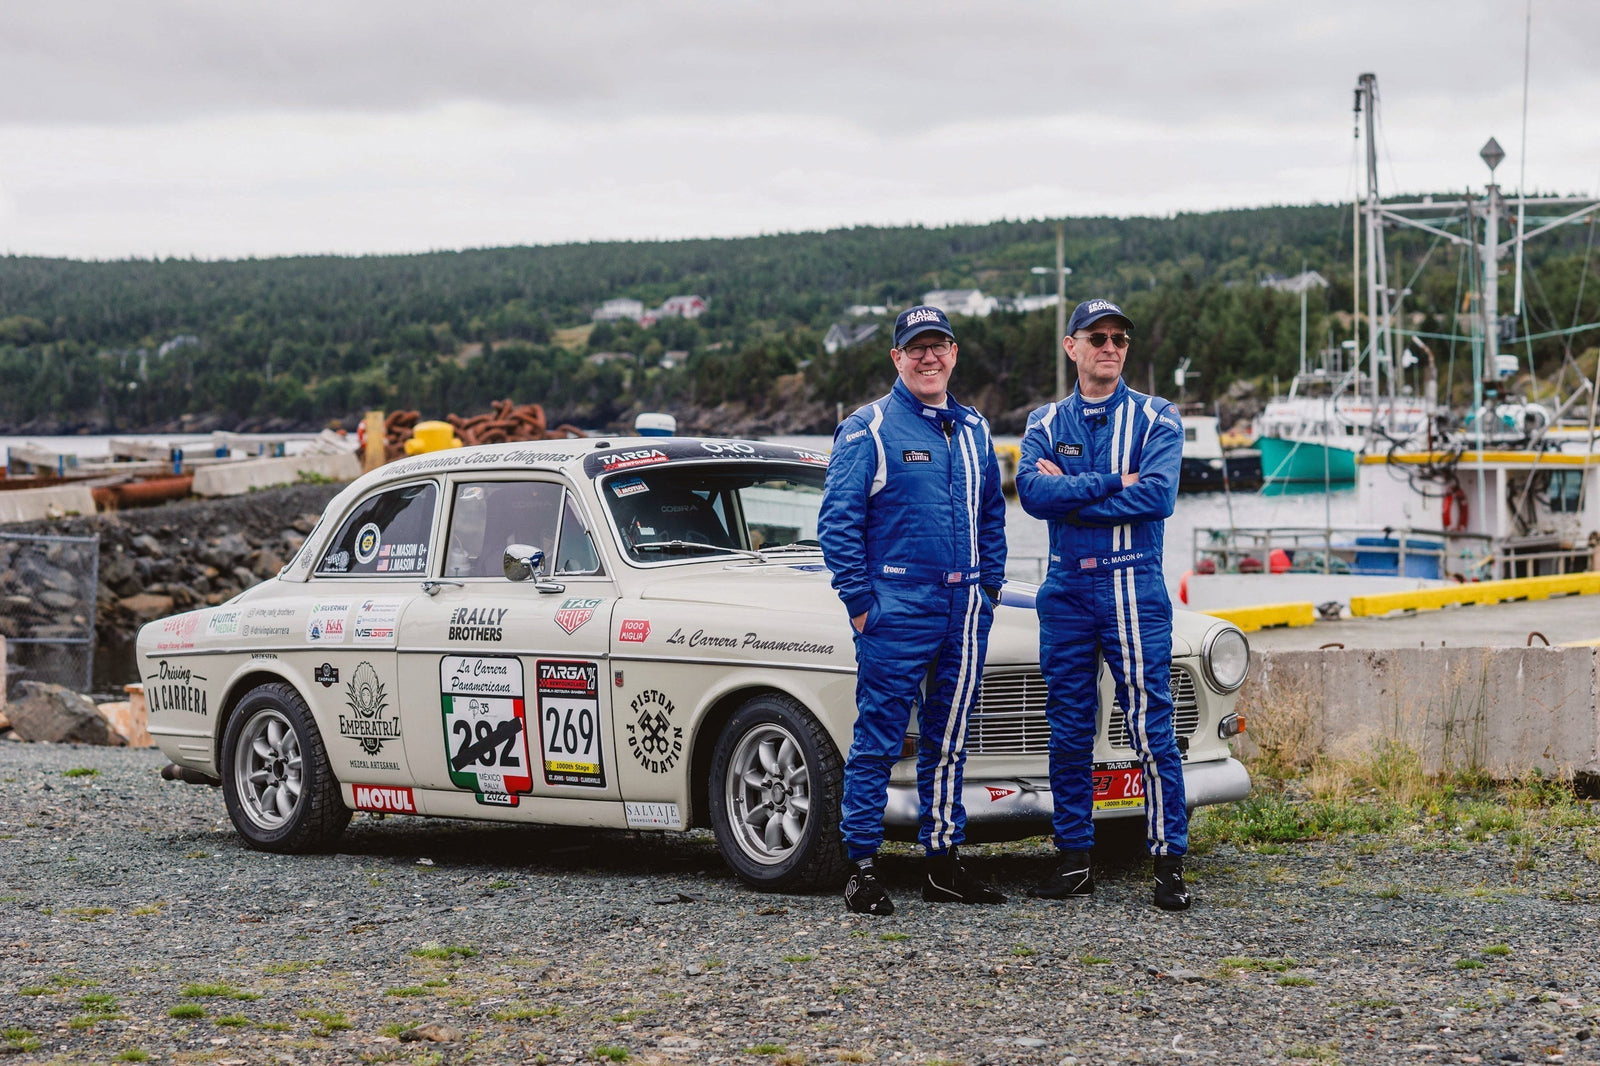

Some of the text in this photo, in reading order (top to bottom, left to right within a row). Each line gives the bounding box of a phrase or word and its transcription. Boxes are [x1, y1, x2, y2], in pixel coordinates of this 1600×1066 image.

[911, 309, 937, 320] RALLY
[1083, 406, 1106, 416] freem
[846, 429, 867, 442] freem
[464, 452, 504, 465] Cosas
[597, 449, 667, 465] TARGA
[617, 456, 667, 468] NEWFOUNDLAND
[622, 484, 645, 494] MOTUL
[661, 504, 699, 512] COBRA
[1111, 554, 1136, 564] MASON
[883, 565, 907, 574] freem
[566, 599, 599, 608] TAG
[456, 607, 509, 625] RALLY
[557, 609, 592, 630] HEUER
[326, 619, 344, 630] K&K
[624, 621, 645, 630] 1000
[448, 626, 503, 642] BROTHERS
[621, 631, 644, 641] MIGLIA
[666, 628, 835, 656] La Carrera Panamericana
[159, 660, 191, 685] Driving
[456, 659, 507, 677] La Carrera
[540, 665, 587, 680] TARGA
[451, 676, 512, 693] Panamericana
[148, 684, 207, 716] LA CARRERA
[630, 689, 676, 716] PISTON
[479, 703, 490, 715] 35
[338, 715, 401, 737] EMPERATRIZ
[545, 707, 594, 755] 269
[626, 723, 683, 774] FOUNDATION
[575, 764, 590, 772] Stage
[1106, 761, 1132, 770] TARGA
[483, 782, 499, 790] RALLY
[356, 787, 413, 811] MOTUL
[484, 789, 508, 802] 2022
[626, 805, 678, 824] SALVAJE
